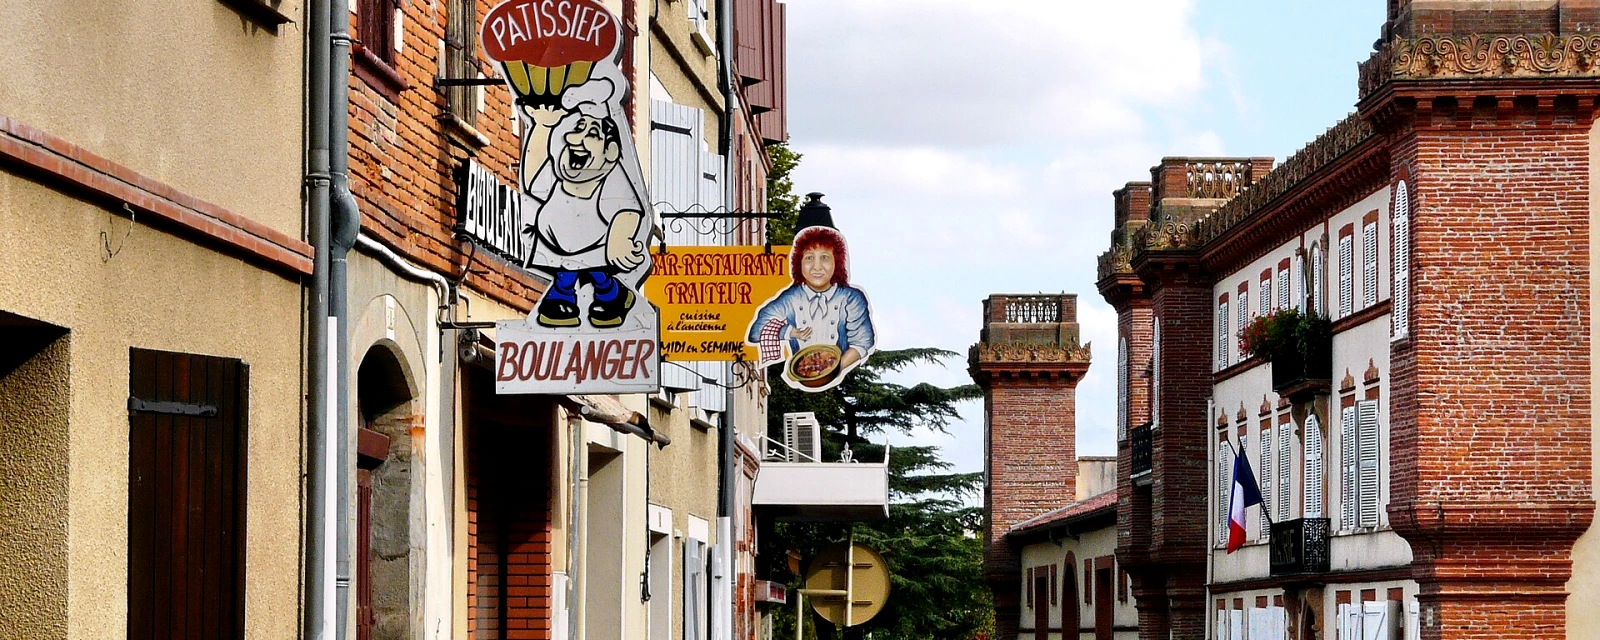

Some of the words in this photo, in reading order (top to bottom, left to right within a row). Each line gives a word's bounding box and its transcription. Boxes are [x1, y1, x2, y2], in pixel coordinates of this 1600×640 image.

[490, 0, 610, 51] PATISSIER
[650, 253, 788, 276] BAR-RESTAURANT
[664, 282, 752, 304] TRAITEUR
[676, 321, 727, 331] l'ancienne
[680, 310, 721, 321] cuisine
[660, 341, 686, 353] MIDI
[687, 344, 698, 353] en
[700, 341, 744, 353] SEMAINE
[496, 339, 655, 384] BOULANGER
